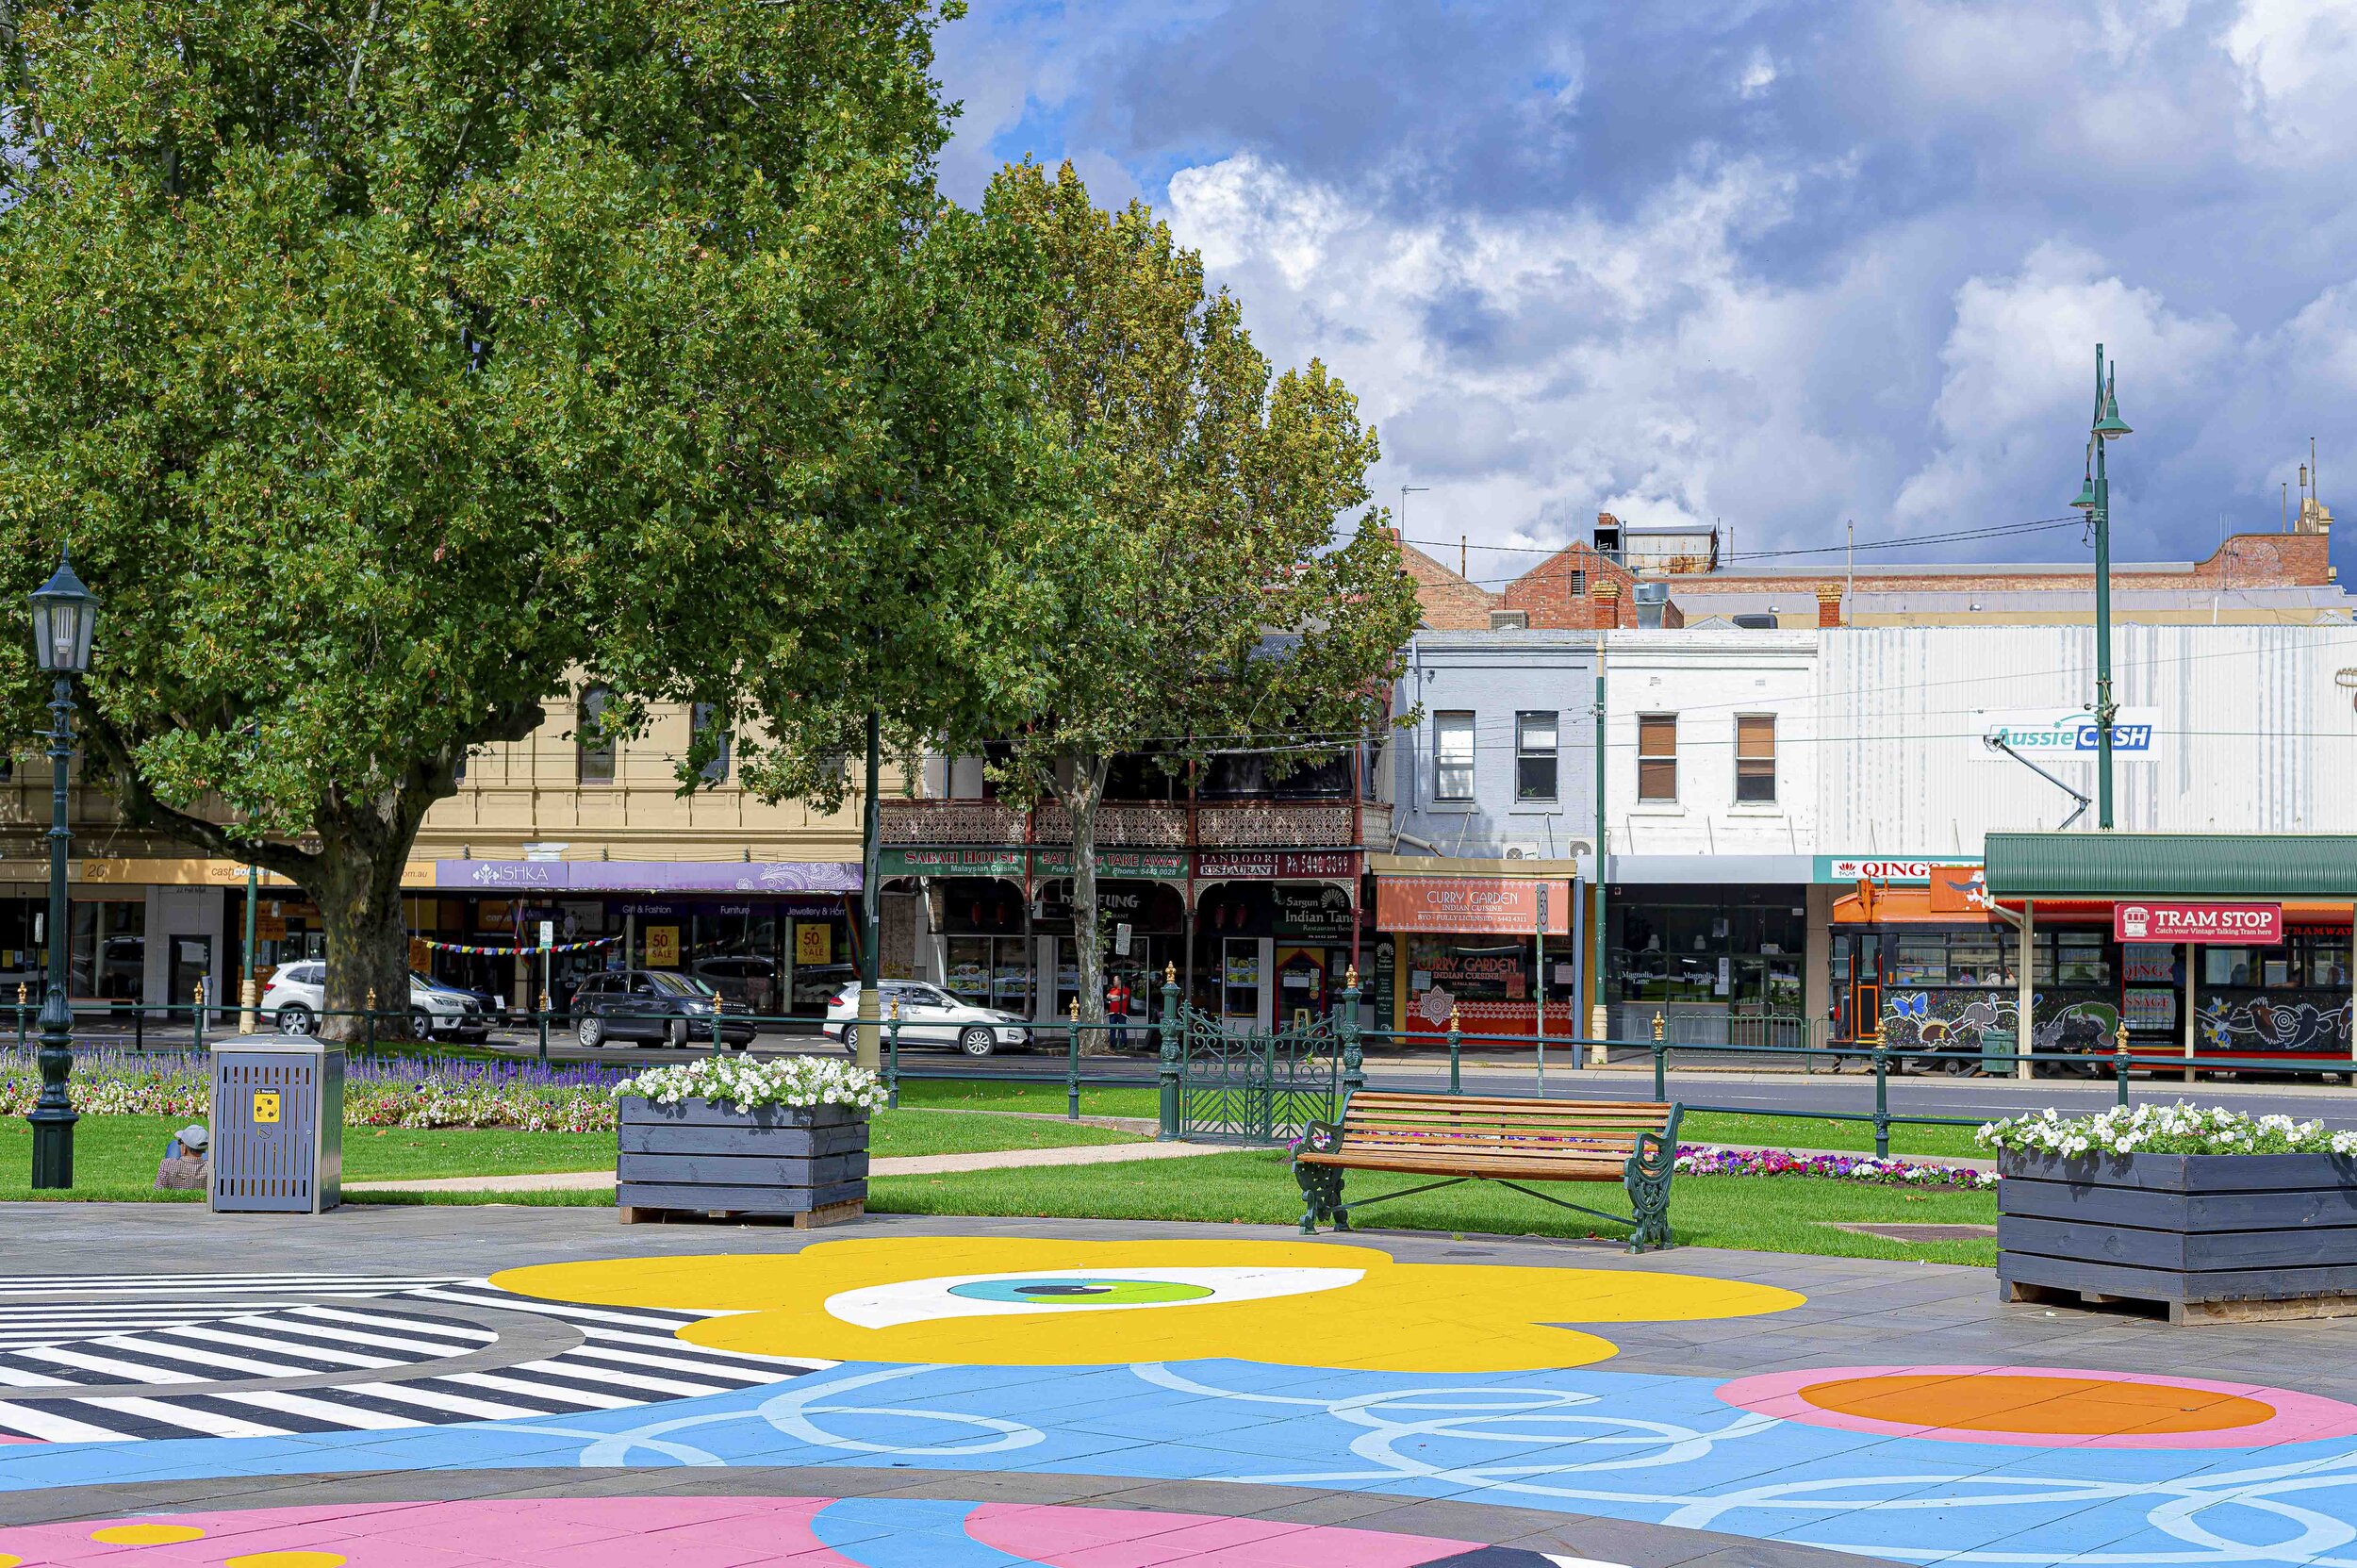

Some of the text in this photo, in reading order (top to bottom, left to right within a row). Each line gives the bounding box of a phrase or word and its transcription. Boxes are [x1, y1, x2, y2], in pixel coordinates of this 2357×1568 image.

[2079, 727, 2149, 747] CSH
[905, 850, 1019, 864] SABAH HOUSE
[1042, 852, 1065, 865] EAT
[1107, 853, 1139, 867] TAKE
[1142, 854, 1182, 867] AWAY
[1199, 854, 1278, 863] TANDOORI
[1287, 855, 1298, 873] Ph
[87, 864, 106, 878] 20
[500, 866, 549, 881] ISHKA
[951, 865, 1019, 874] Malaysian Cuisine
[1051, 866, 1069, 874] Fully
[1286, 896, 1319, 908] Sargun
[1426, 890, 1518, 905] CURRY GARDEN
[644, 905, 672, 914] Fashion
[720, 905, 750, 915] Furniture
[787, 907, 819, 917] Jewellery
[1285, 910, 1325, 923] Indian
[2154, 910, 2273, 927] TRAM STOP
[1302, 924, 1336, 933] Restaurant
[2191, 927, 2215, 935] Vintage
[2216, 928, 2239, 936] Talking
[652, 949, 672, 959] SALE
[803, 948, 824, 957] SALE
[1416, 957, 1517, 973] CURRY GARDEN
[1622, 971, 1653, 980] Magnolia
[1684, 971, 1715, 981] Magnolia
